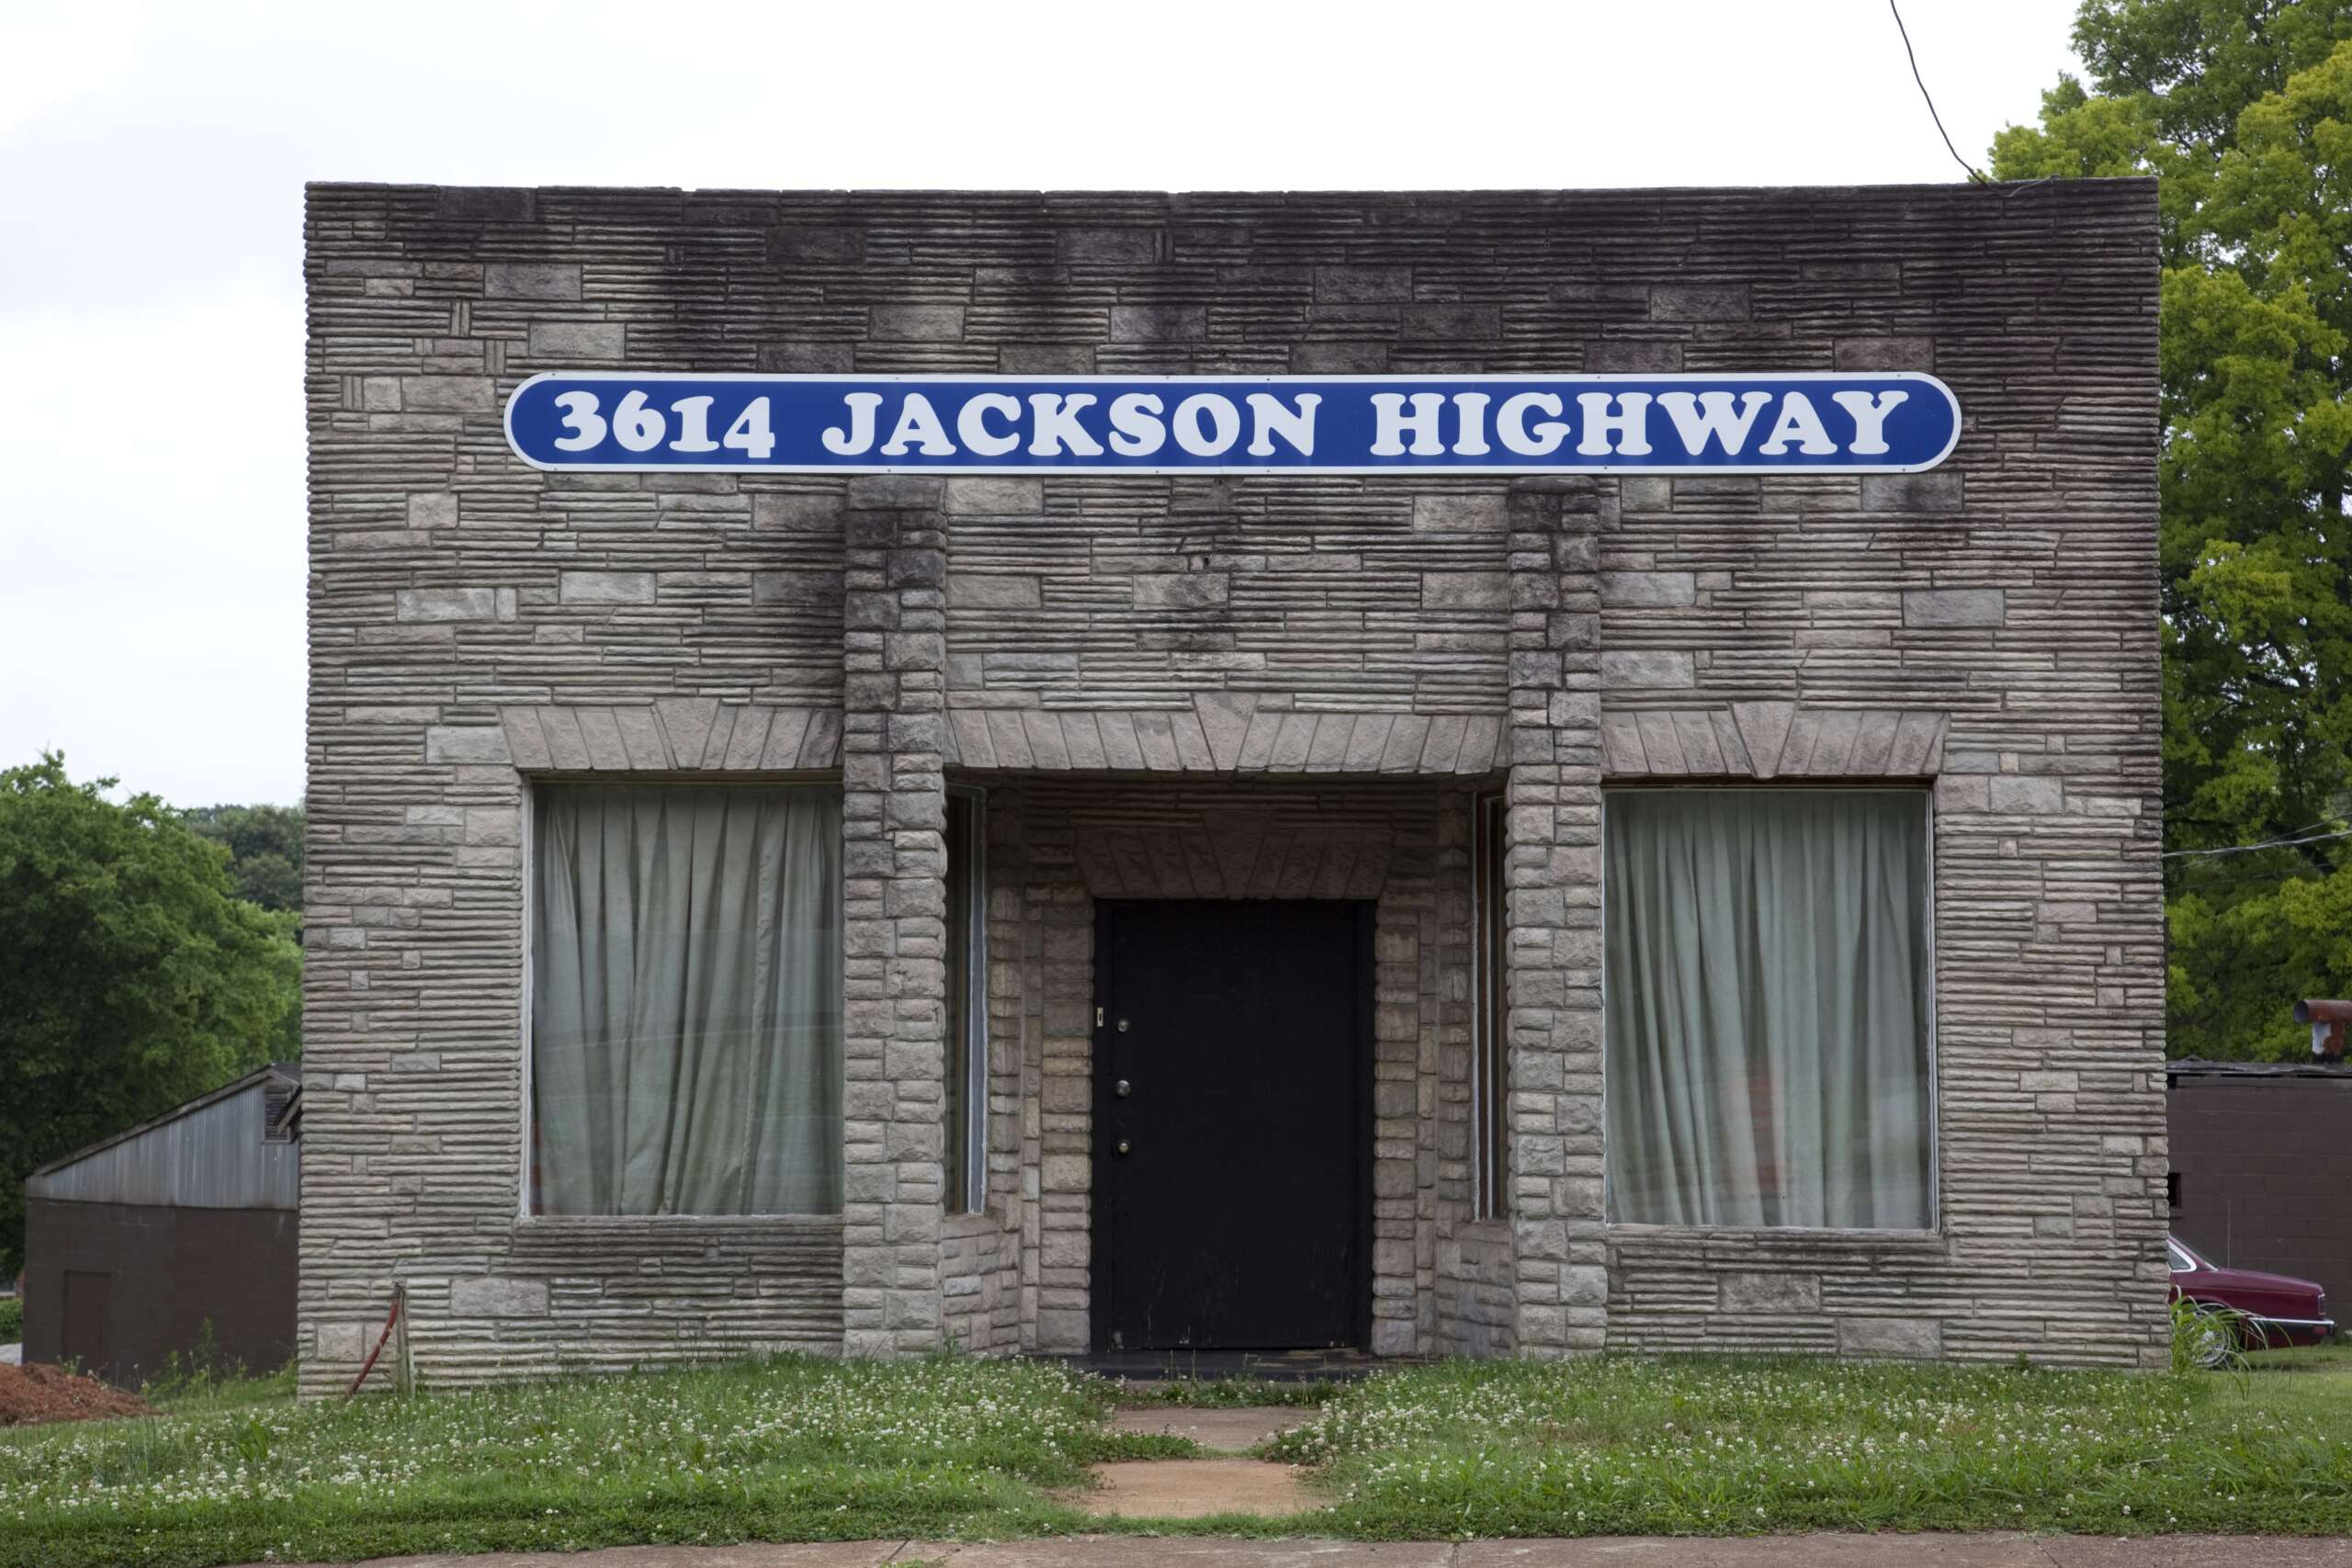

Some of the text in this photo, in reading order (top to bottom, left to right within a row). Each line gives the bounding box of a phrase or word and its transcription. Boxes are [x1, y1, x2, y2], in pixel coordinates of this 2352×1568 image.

[554, 390, 1909, 458] 3614 JACKSON HIGHWAY
